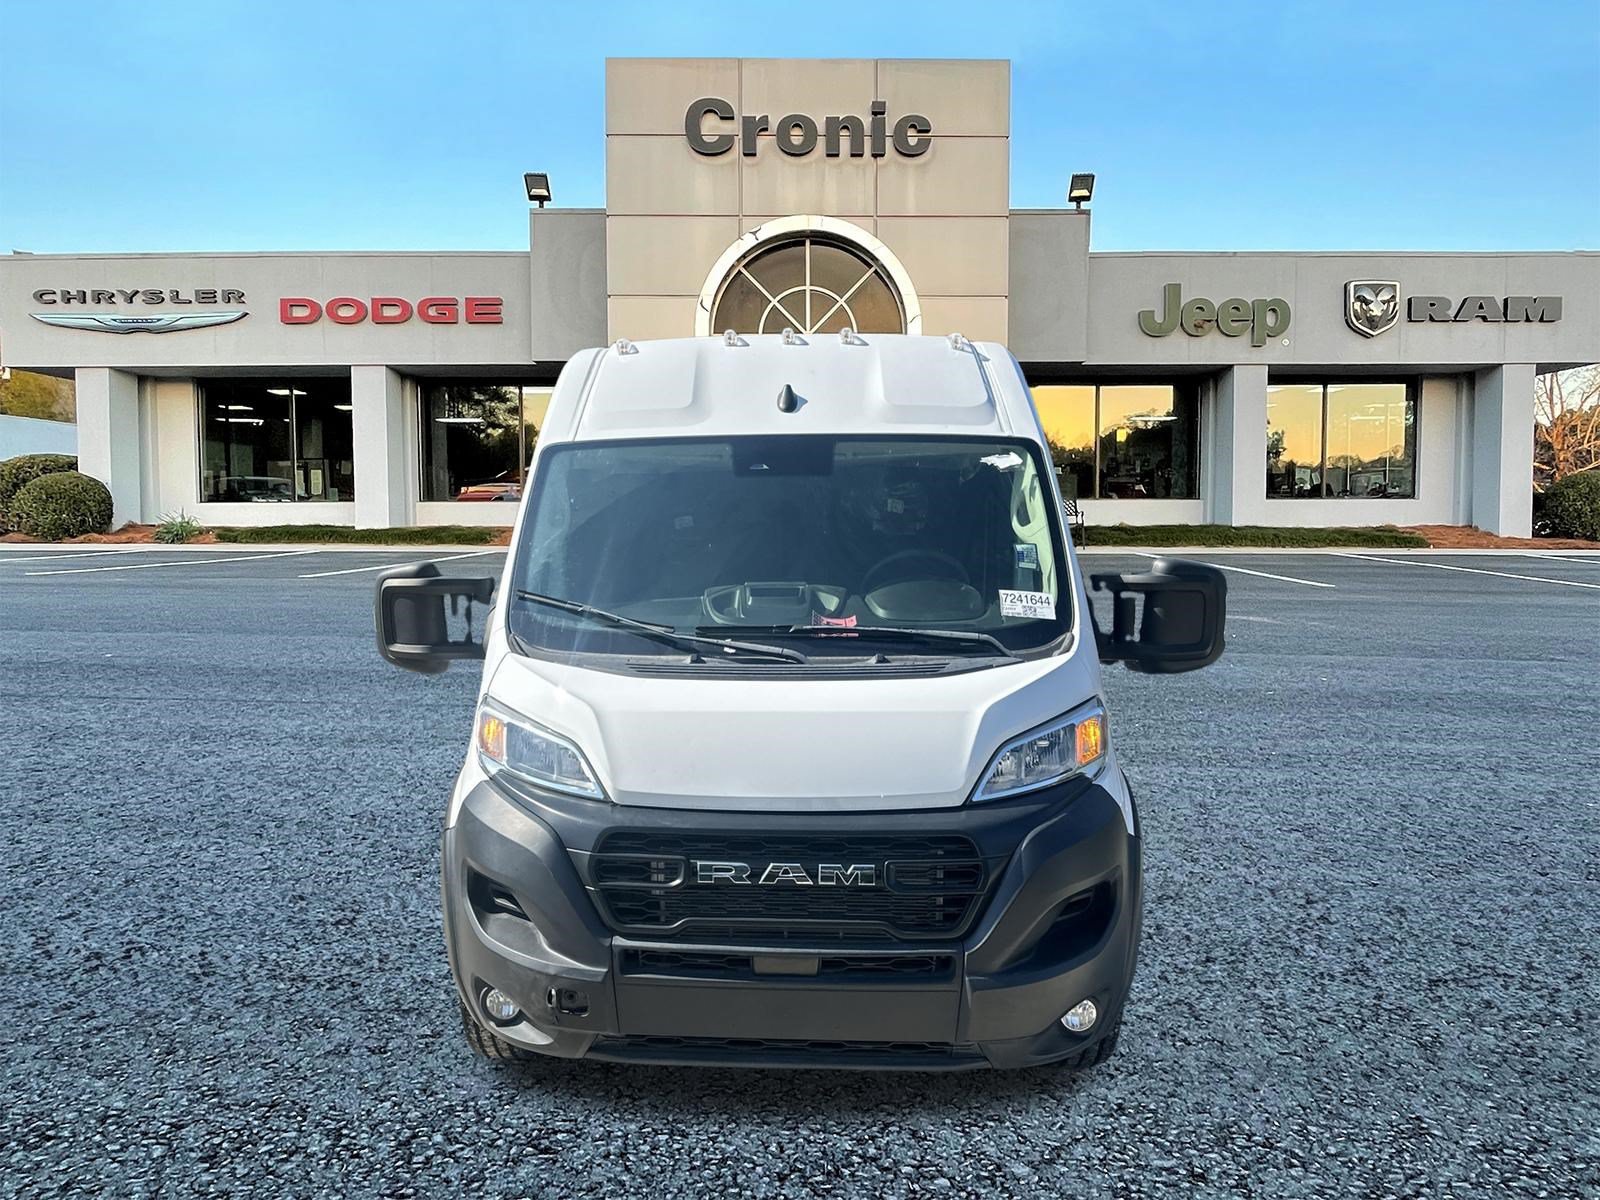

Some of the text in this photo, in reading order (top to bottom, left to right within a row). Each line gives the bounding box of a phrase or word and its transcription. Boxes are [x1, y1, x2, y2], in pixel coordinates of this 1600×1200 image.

[685, 97, 932, 157] Cronic
[32, 289, 246, 304] CHRYSLER
[1407, 296, 1563, 322] RAM
[279, 297, 503, 324] DODGE
[1138, 283, 1291, 347] Jeep
[1002, 593, 1050, 606] 7241644
[692, 860, 876, 886] RAM
